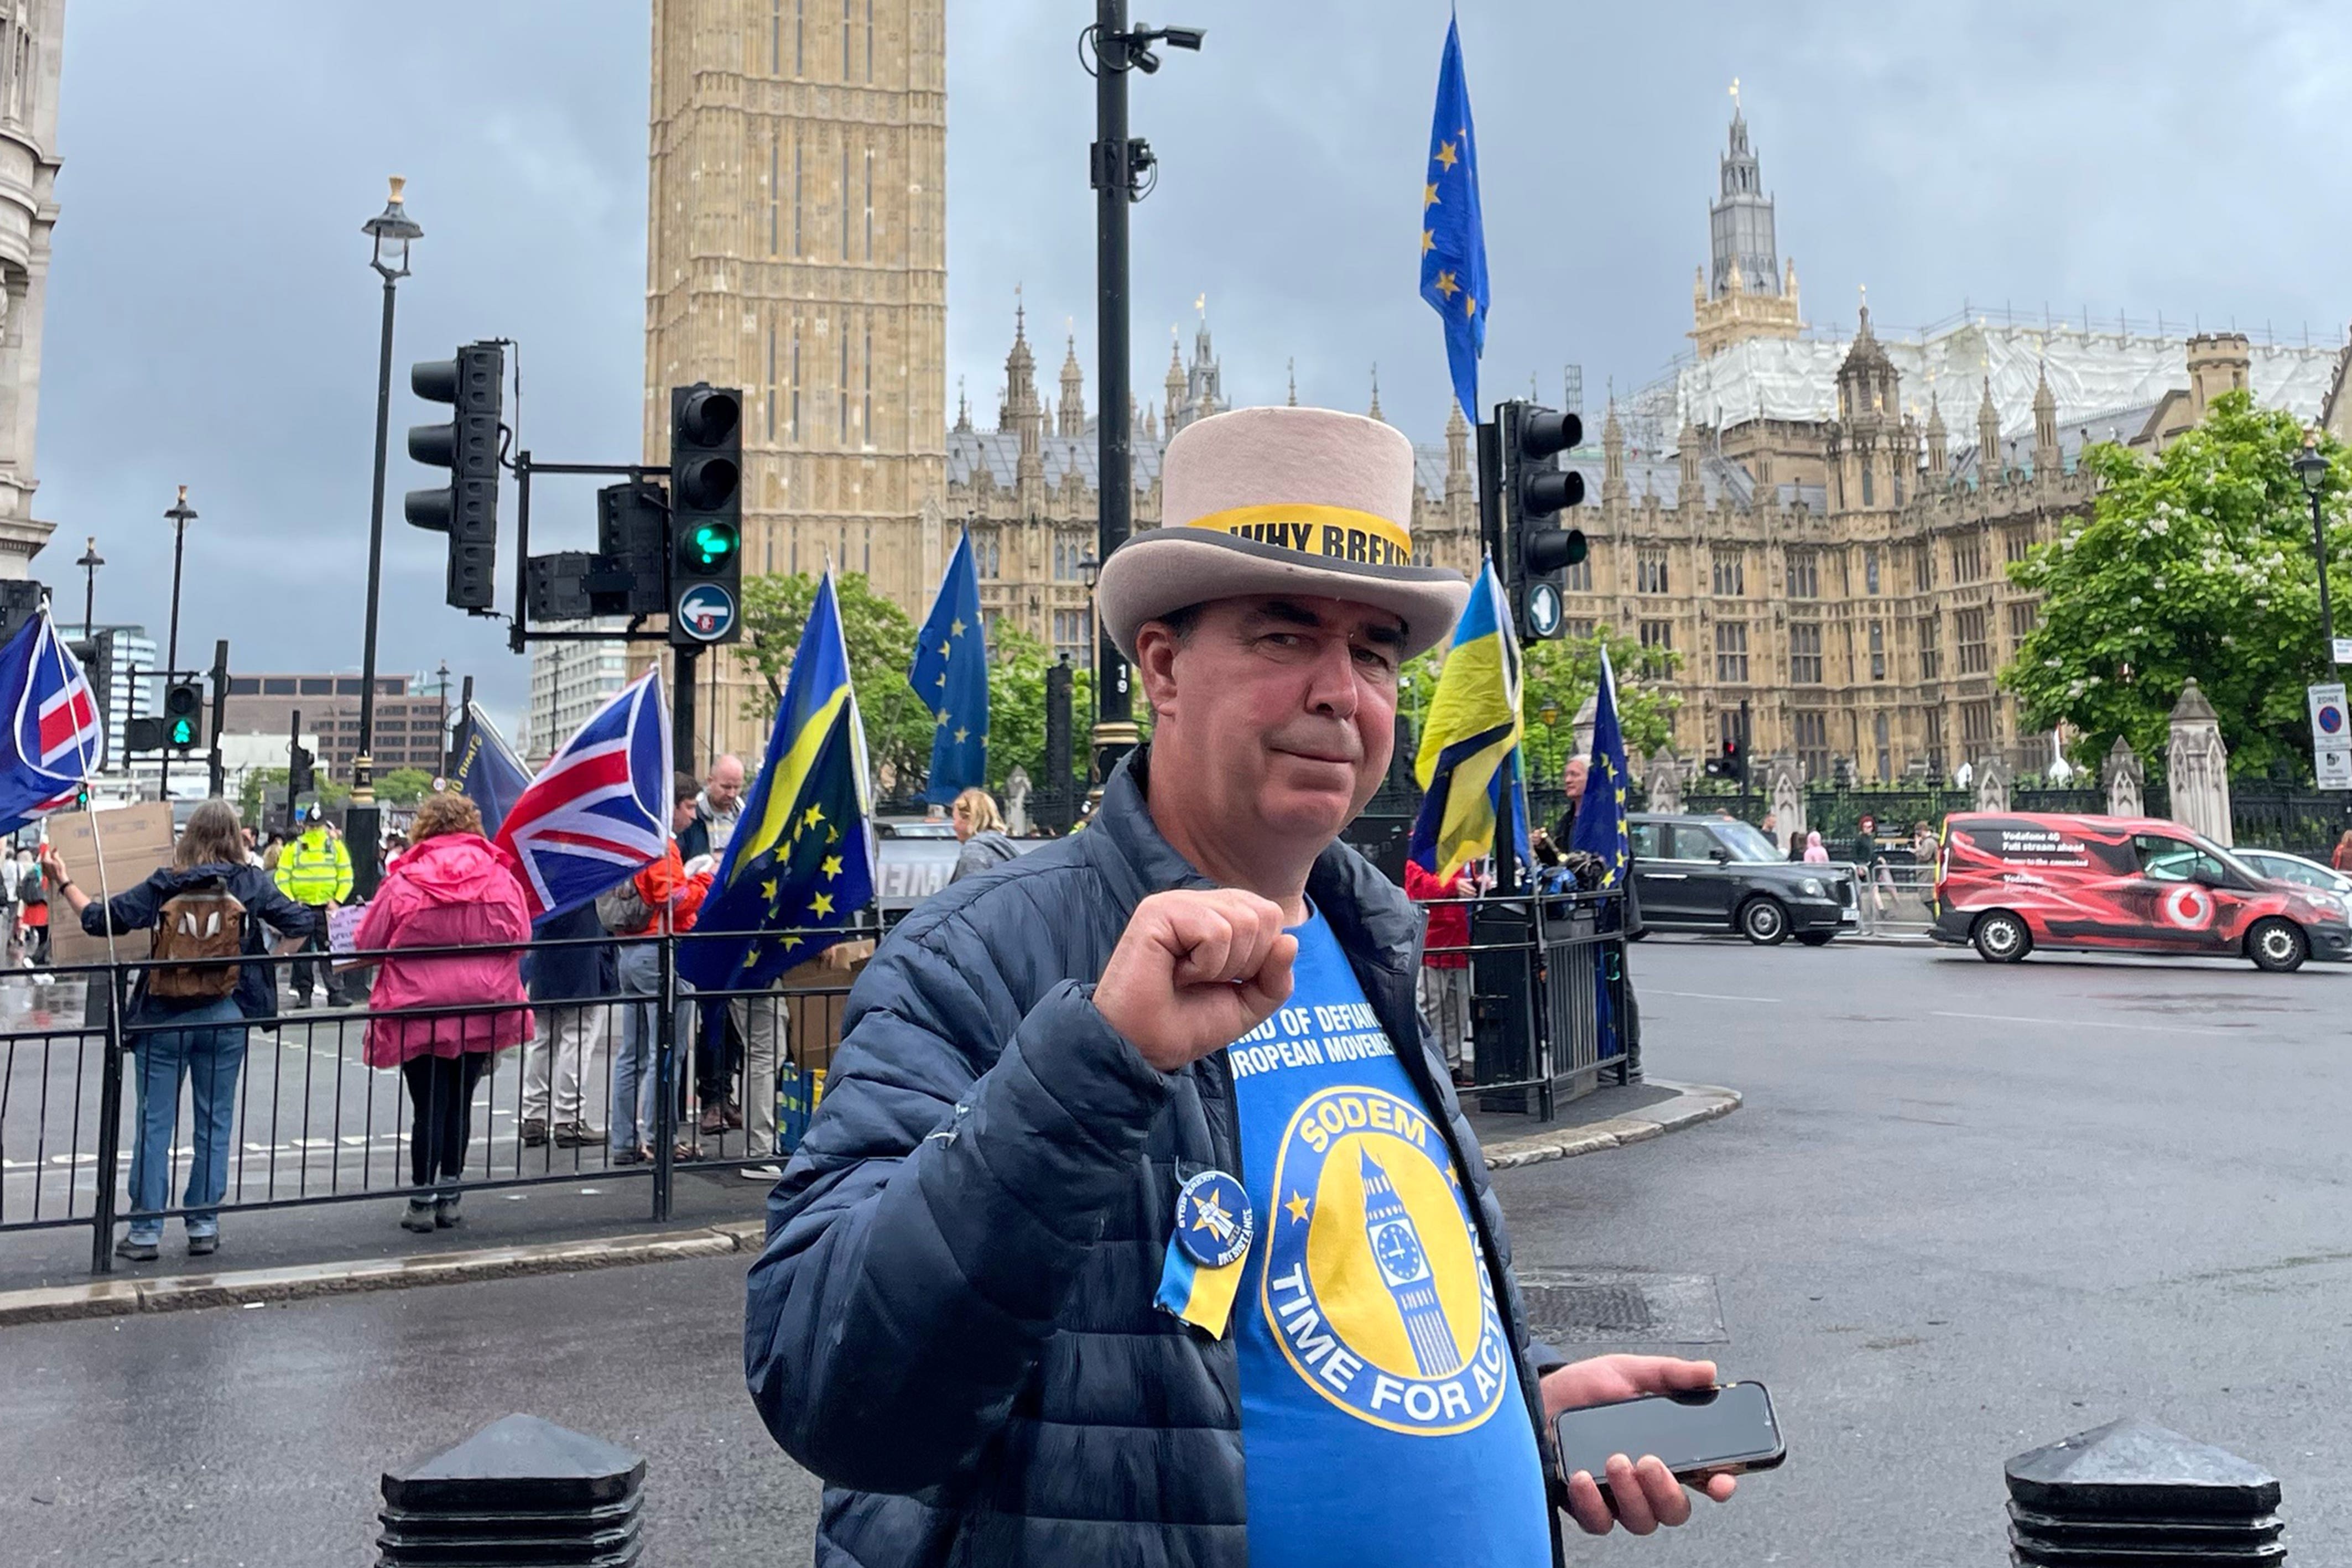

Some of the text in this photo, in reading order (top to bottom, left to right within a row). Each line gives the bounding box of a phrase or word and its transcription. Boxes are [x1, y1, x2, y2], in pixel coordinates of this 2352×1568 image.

[1279, 1008, 1312, 1036] OF
[1323, 1033, 1394, 1063] MOVEME
[1301, 1097, 1425, 1153] SODEM
[1178, 1174, 1217, 1228] STOP BREXIT
[1273, 1262, 1363, 1393] TIME
[1370, 1374, 1472, 1420] FOR
